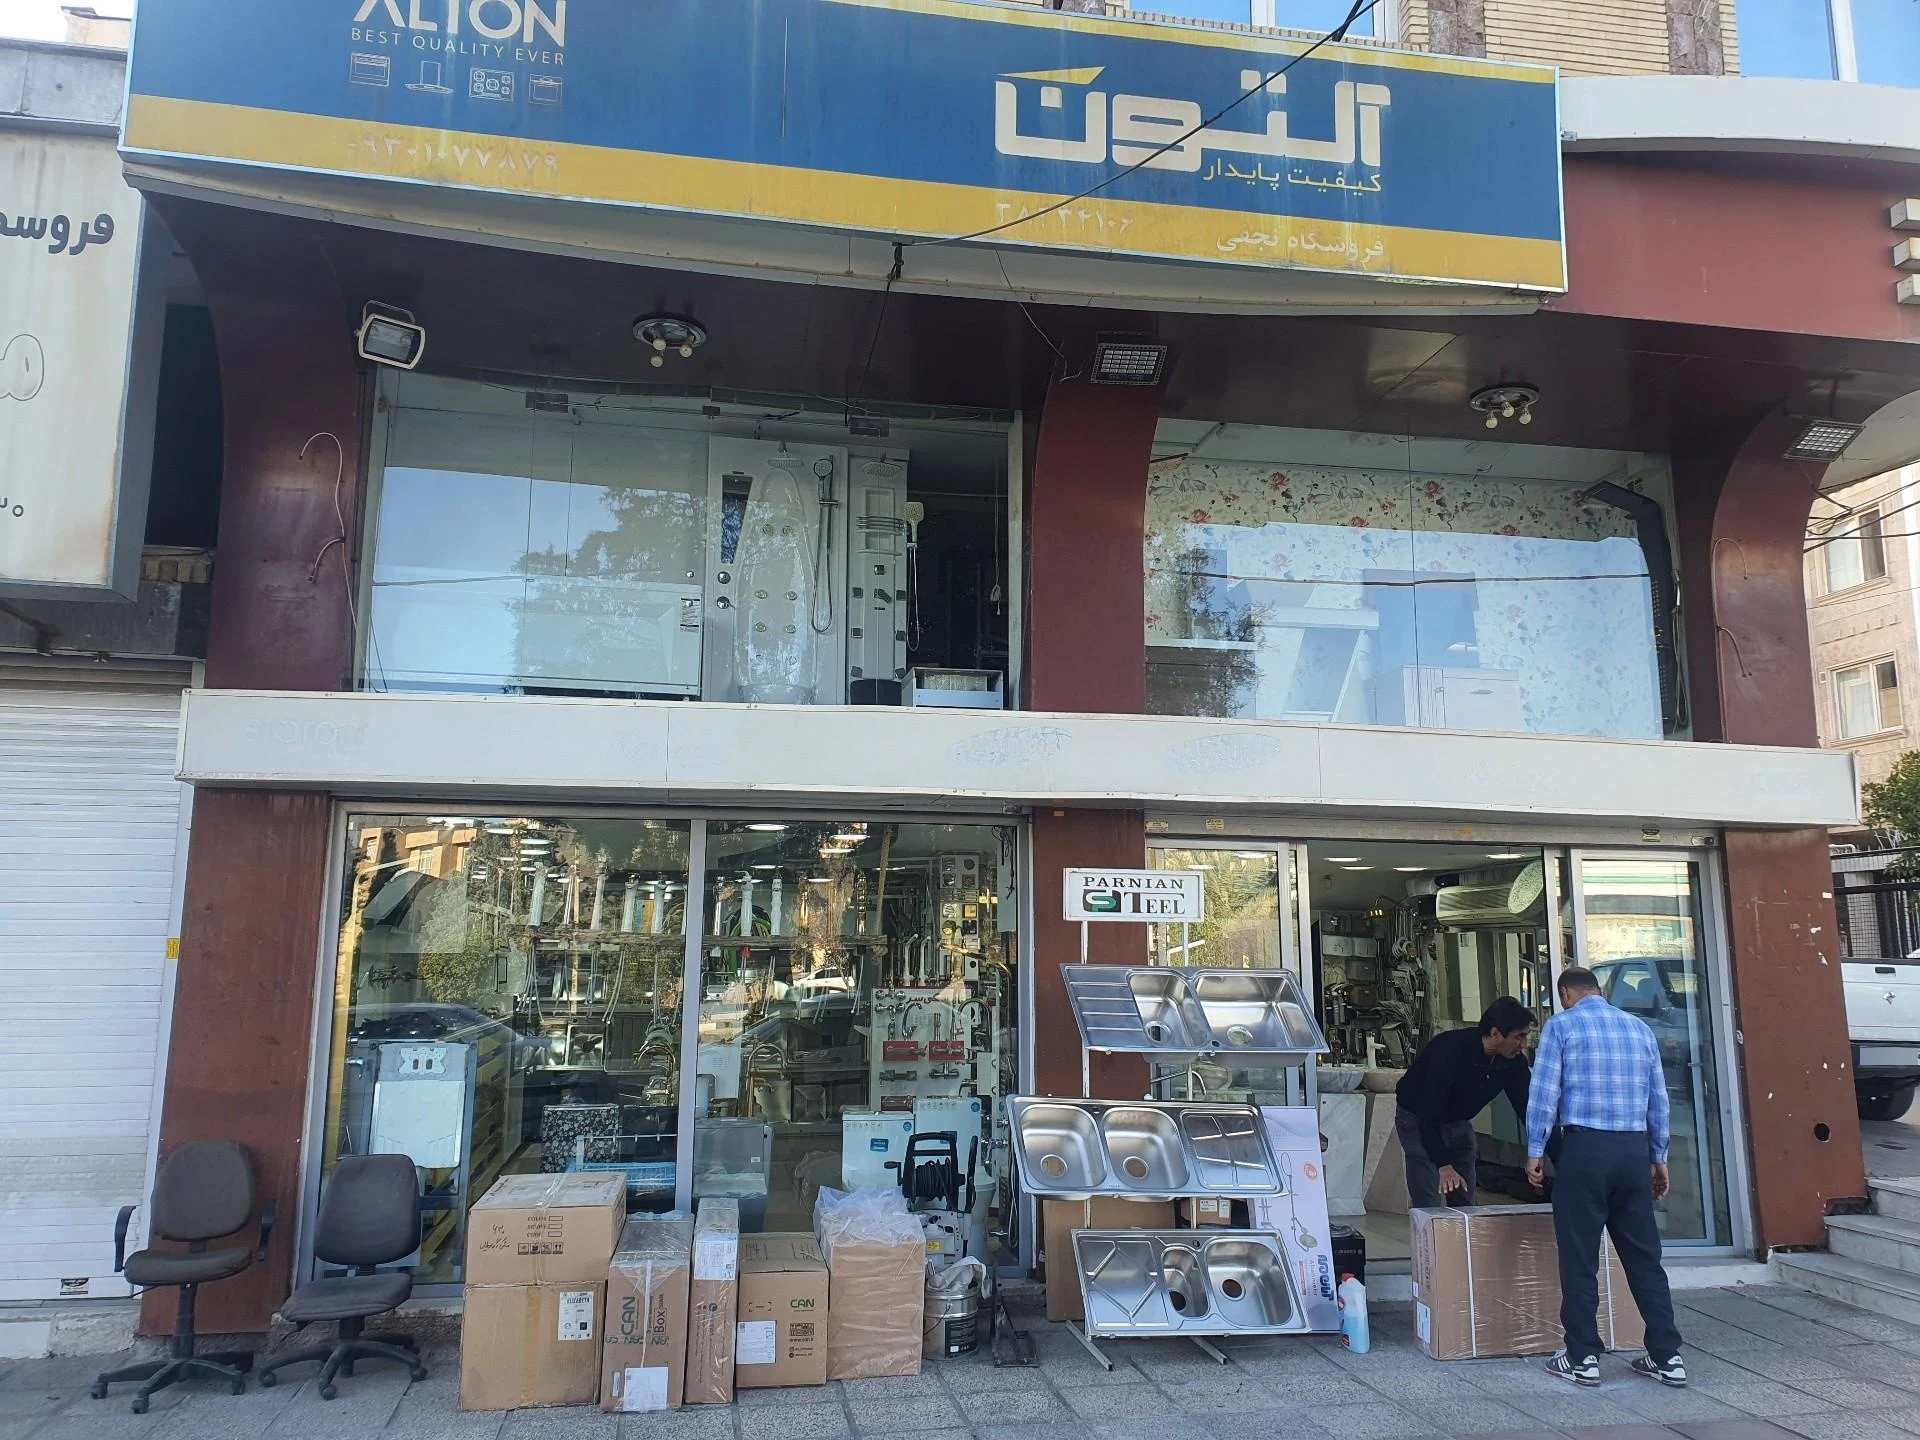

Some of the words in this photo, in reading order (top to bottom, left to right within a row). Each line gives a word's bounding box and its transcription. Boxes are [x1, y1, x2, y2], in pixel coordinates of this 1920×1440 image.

[351, 27, 401, 45] BEST
[412, 35, 504, 58] QUALITY
[515, 48, 565, 66] EVER
[995, 67, 1391, 173] آلتون
[1203, 157, 1280, 191] پایدار
[1287, 169, 1382, 196] کیفیت
[1082, 876, 1185, 889] PARNIAN
[621, 1296, 636, 1336] CAN
[790, 1298, 815, 1309] CAN
[654, 1310, 666, 1333] Box
